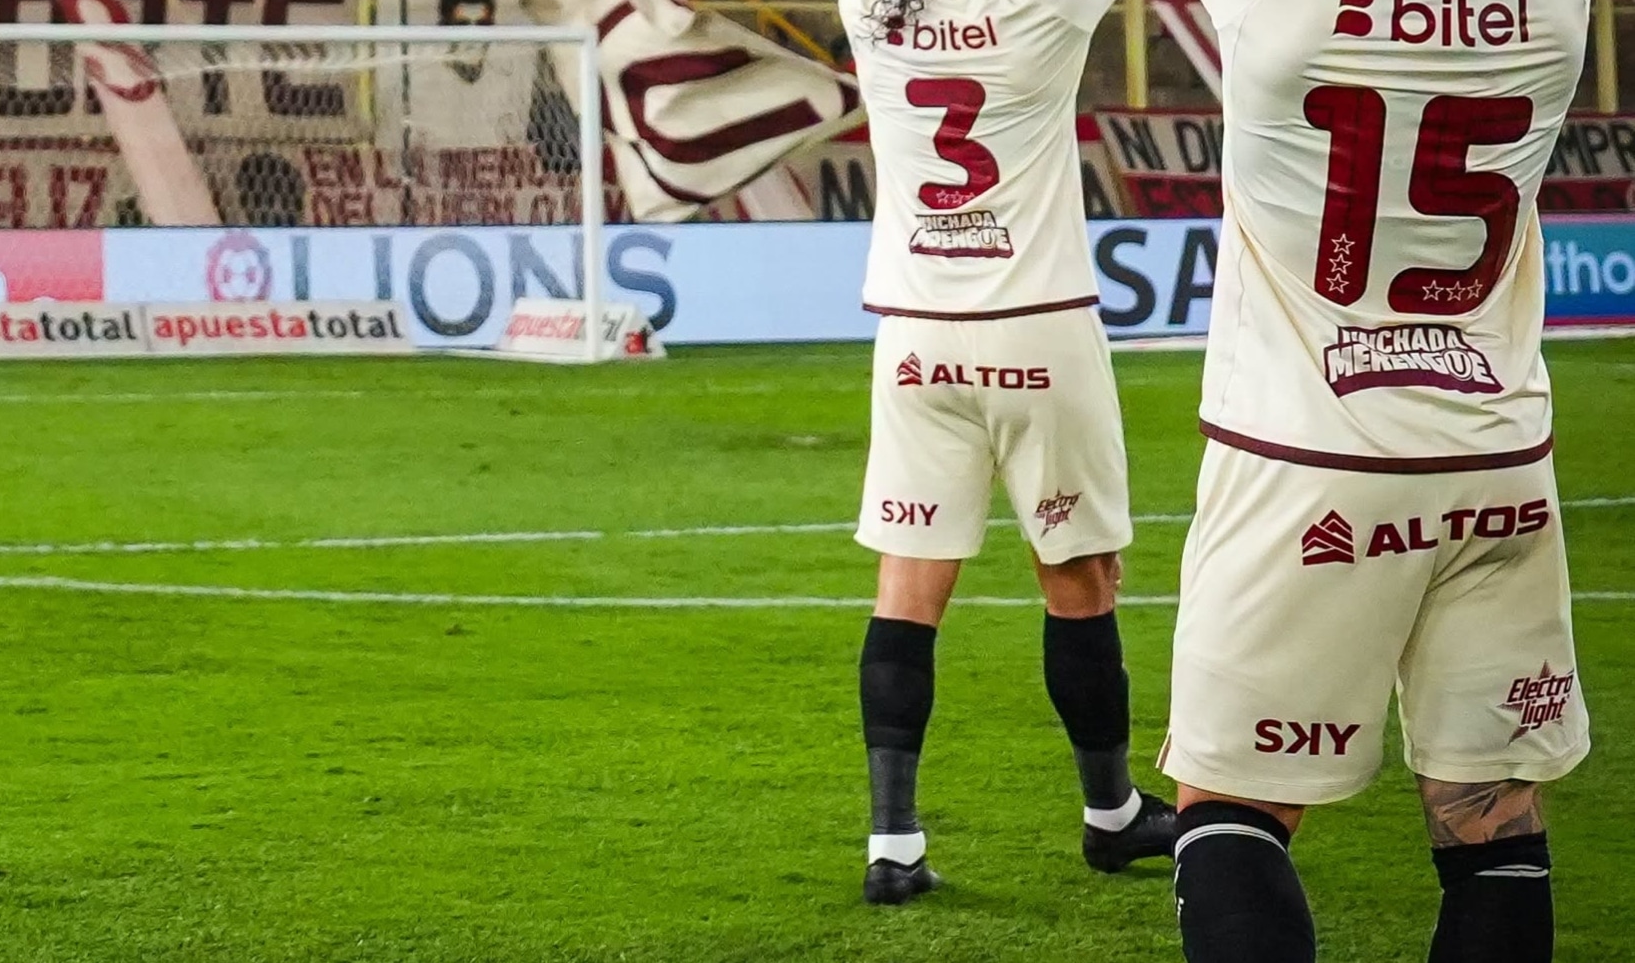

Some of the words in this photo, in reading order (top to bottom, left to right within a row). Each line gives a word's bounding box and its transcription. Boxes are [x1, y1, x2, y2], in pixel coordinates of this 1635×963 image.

[913, 16, 998, 51] bitel
[905, 78, 1000, 210] 3
[1303, 85, 1535, 316] 15
[916, 212, 996, 231] INCHADA
[153, 308, 405, 347] apuestatotal
[930, 364, 1051, 390] ALTOS
[881, 500, 939, 526] SKY
[1366, 497, 1549, 558] ALTOS
[1507, 670, 1572, 705] Electro
[1520, 694, 1567, 730] light
[1254, 719, 1362, 756] SKY
